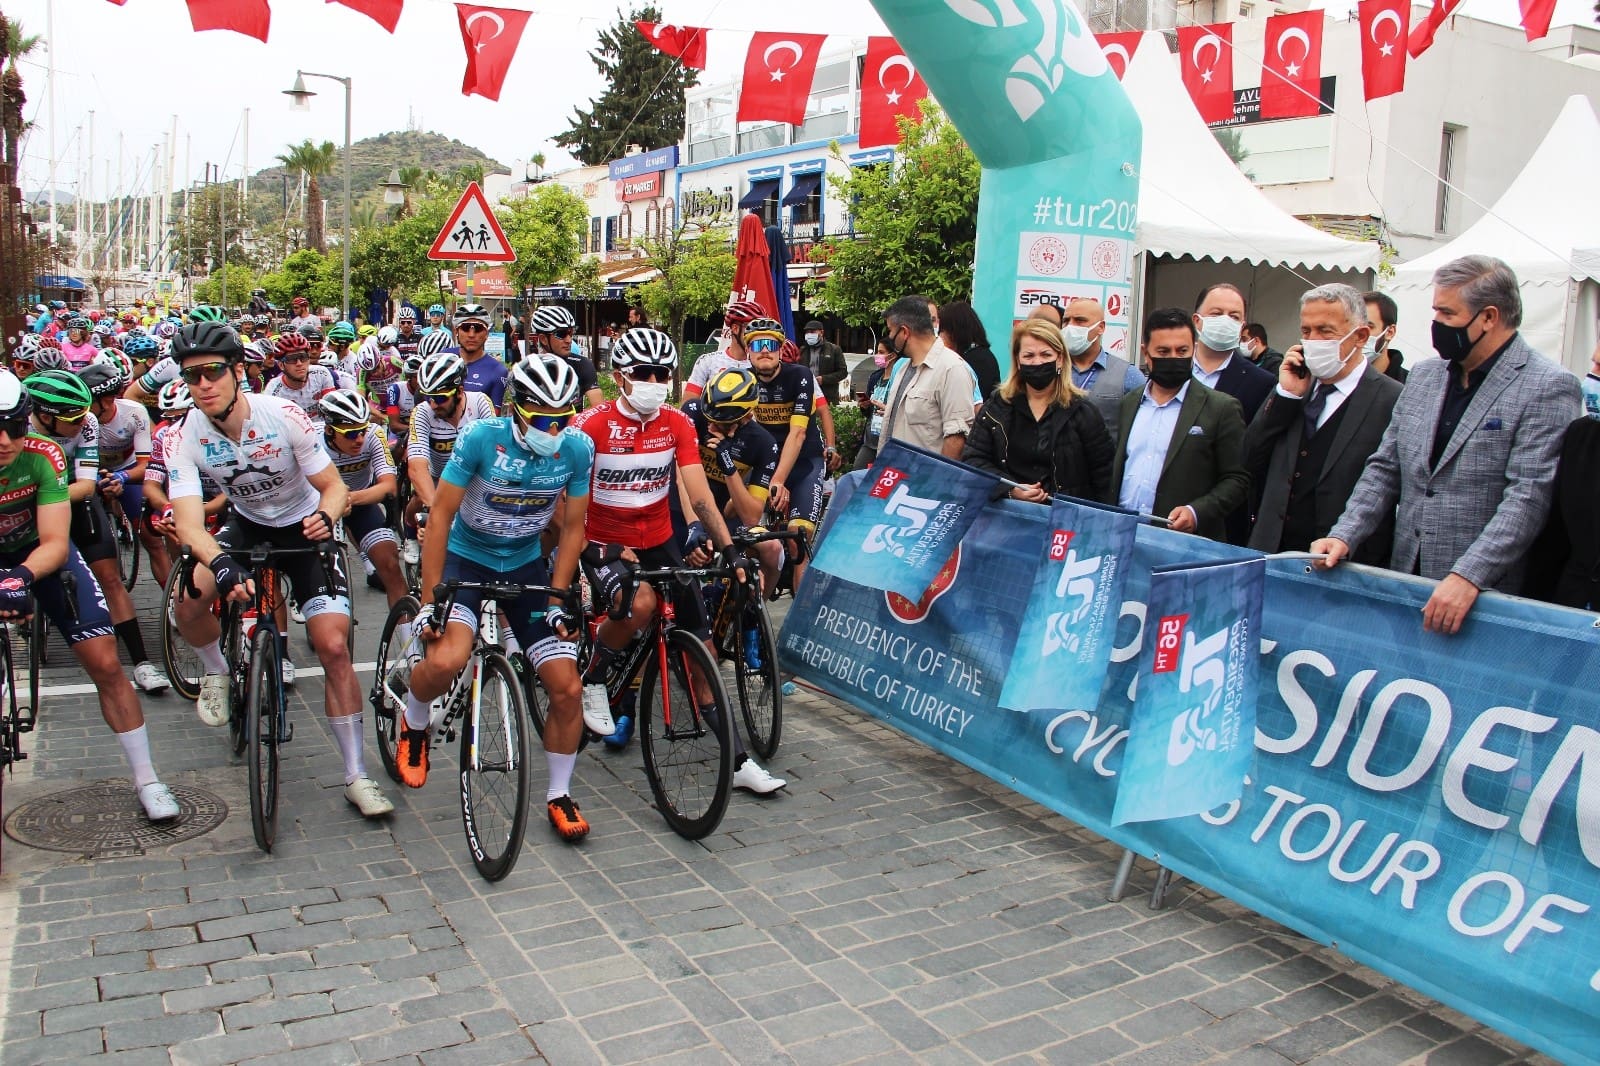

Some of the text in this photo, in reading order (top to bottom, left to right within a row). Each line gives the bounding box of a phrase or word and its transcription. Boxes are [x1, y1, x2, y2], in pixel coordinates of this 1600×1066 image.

[633, 180, 656, 193] MARKET
[23, 439, 67, 471] ALCANO
[0, 485, 37, 501] ALCAN
[490, 495, 548, 506] DELKO
[814, 605, 917, 665] PRESIDENCY
[917, 647, 946, 676] OF
[947, 657, 983, 697] THE
[802, 640, 974, 738] REPUBLIC OF TURKEY
[1251, 786, 1441, 910] TOUR
[1447, 871, 1590, 954] OF
